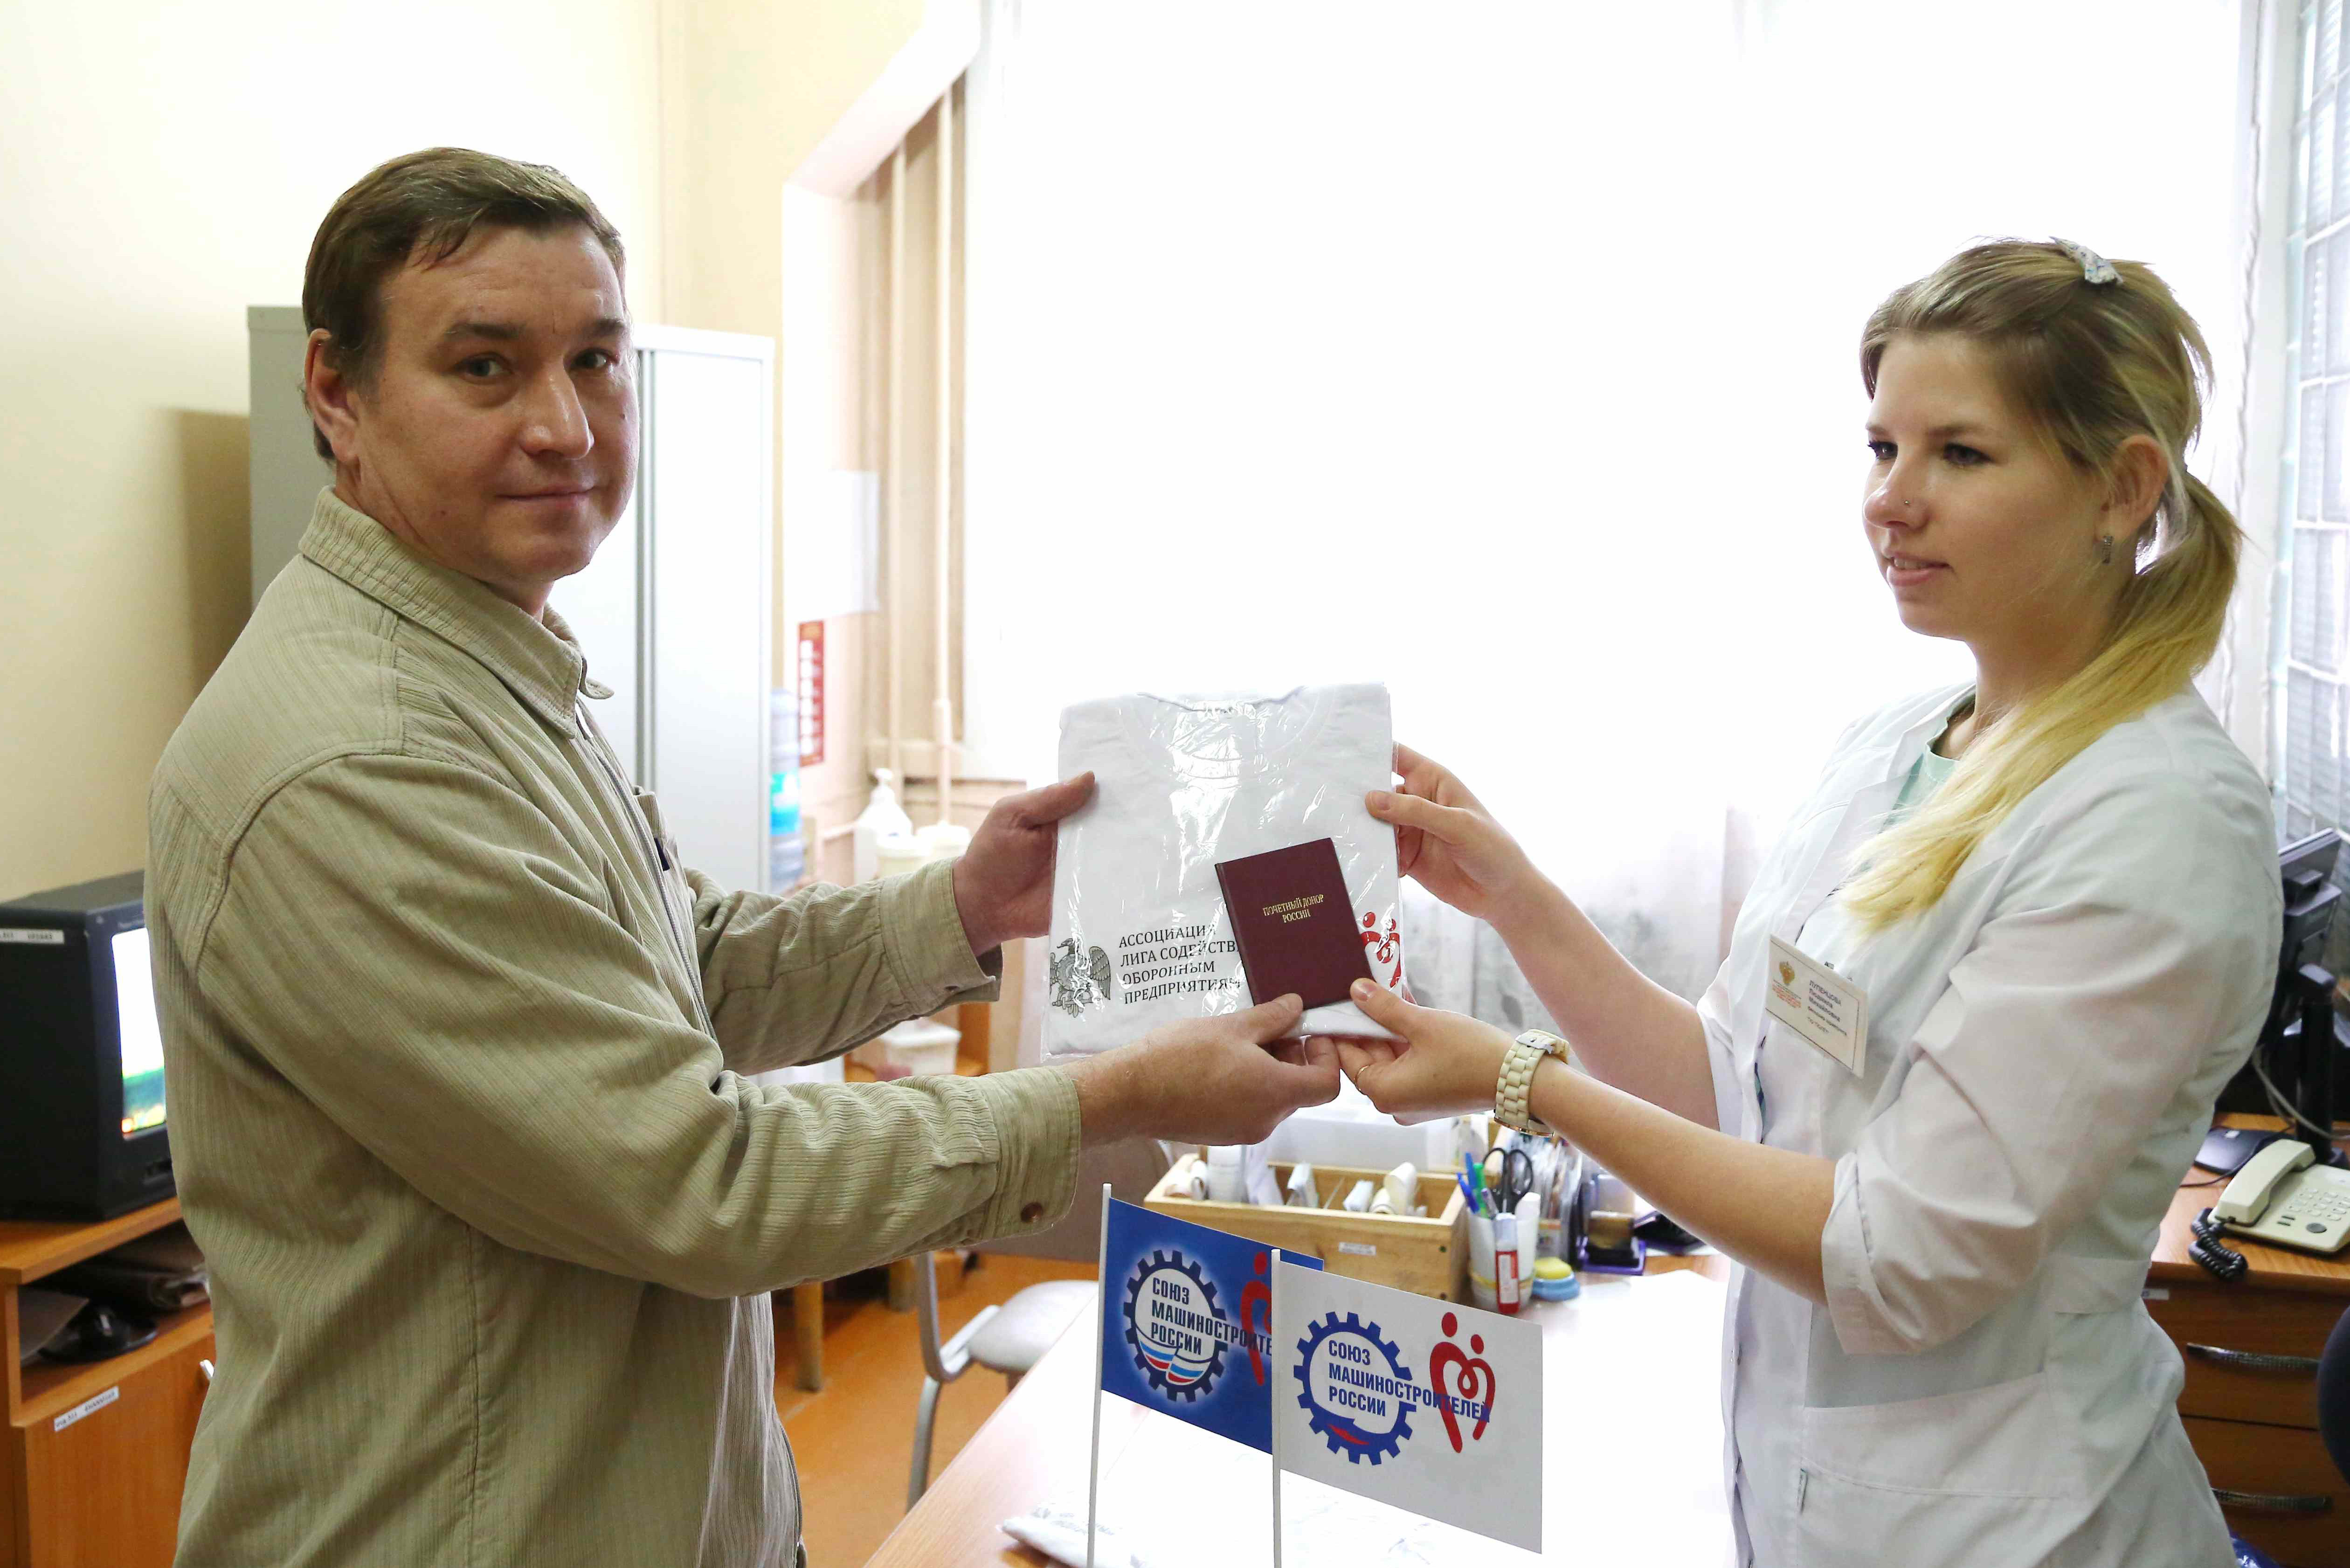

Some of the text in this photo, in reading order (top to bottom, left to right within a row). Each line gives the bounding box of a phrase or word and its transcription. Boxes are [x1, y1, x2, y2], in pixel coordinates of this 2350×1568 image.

[1262, 894, 1324, 916] ПОЧЕТНЫЙ ДОНОР
[1282, 909, 1311, 923] РОССИИ
[1120, 940, 1238, 967] ЛИГА СОДЕЙСТВ
[1123, 961, 1215, 984] ОБОРОННЫМ
[1153, 1278, 1189, 1305] СОЮЗ
[1151, 1322, 1202, 1355] РОССИИ
[1329, 1340, 1370, 1366] СОЮЗ
[1329, 1363, 1490, 1423] МАШИНОСТРОИТЕЛЕЙ
[1329, 1386, 1385, 1416] РОССИИ
